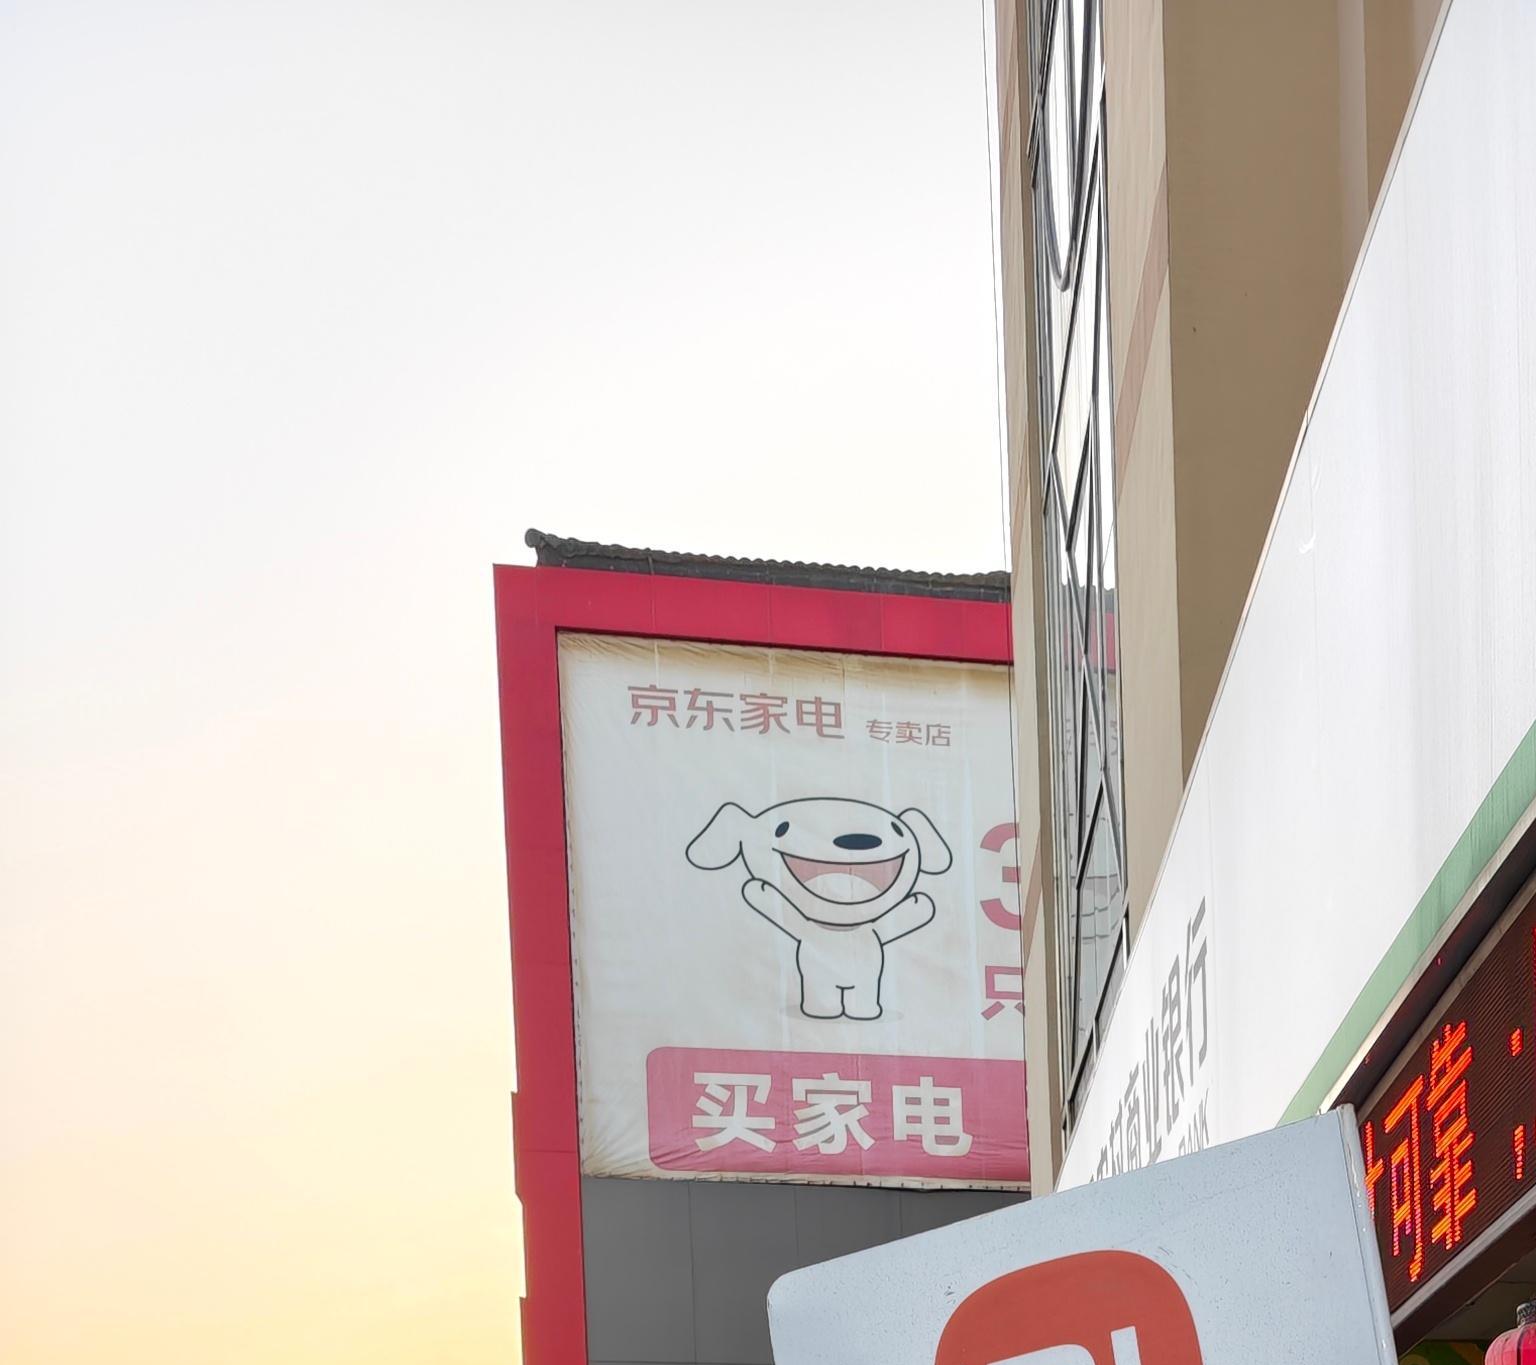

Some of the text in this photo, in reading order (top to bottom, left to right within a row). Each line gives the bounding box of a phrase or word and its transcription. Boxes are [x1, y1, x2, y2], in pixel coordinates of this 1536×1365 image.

[627, 684, 952, 748] 京东家电 专卖店
[691, 1071, 972, 1157] 买家电
